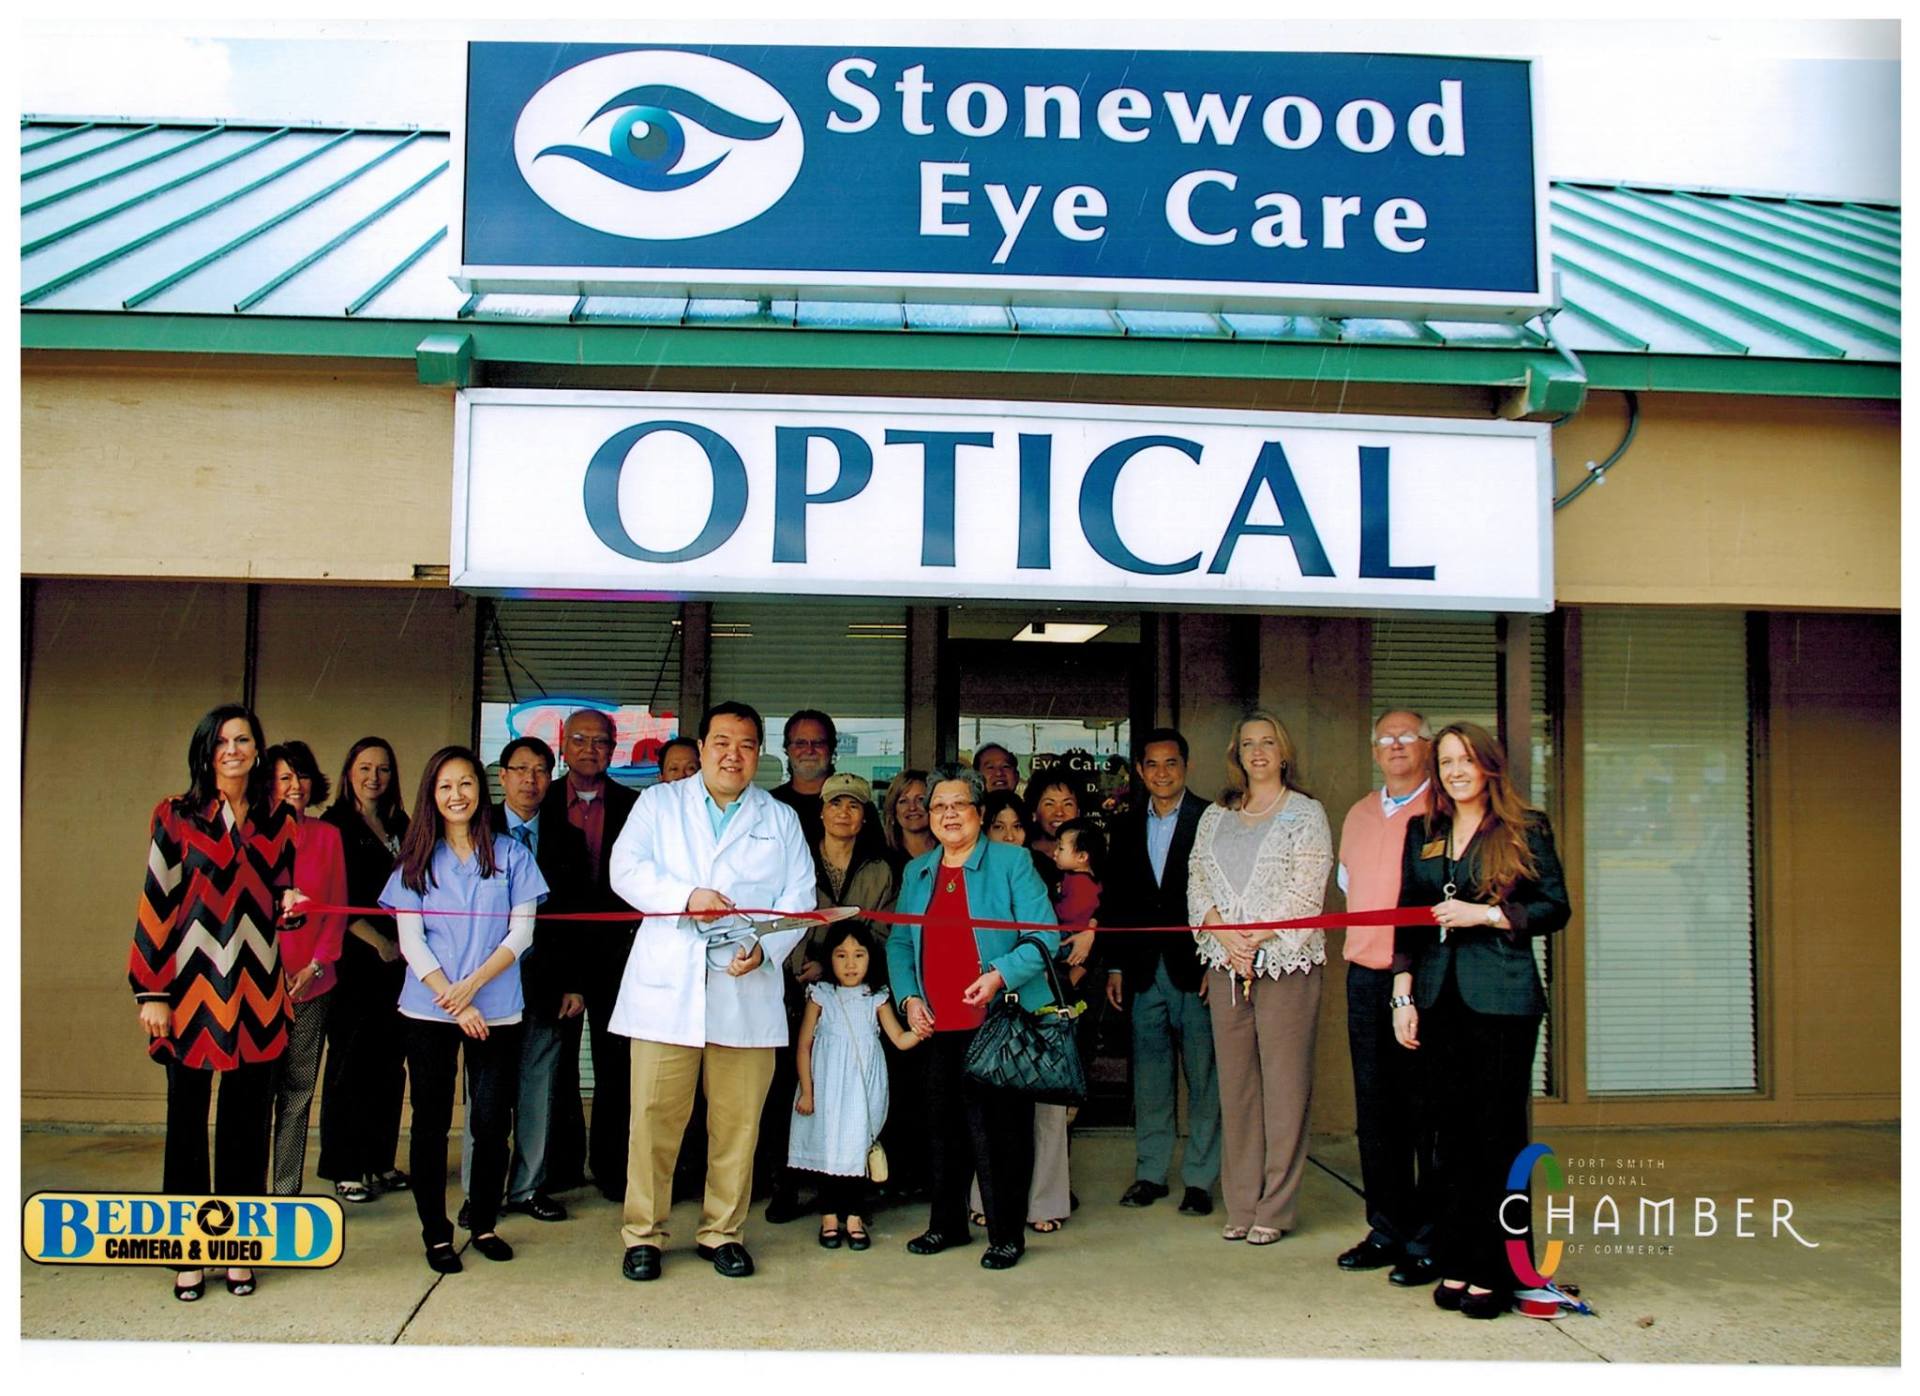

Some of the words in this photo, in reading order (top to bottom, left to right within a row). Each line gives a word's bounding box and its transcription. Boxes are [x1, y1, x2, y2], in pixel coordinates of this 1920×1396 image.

[826, 58, 1465, 156] Stonewood
[919, 162, 1107, 264] Eye
[1165, 169, 1427, 253] Care
[583, 420, 1436, 582] OPTICAL
[1069, 757, 1111, 771] Care
